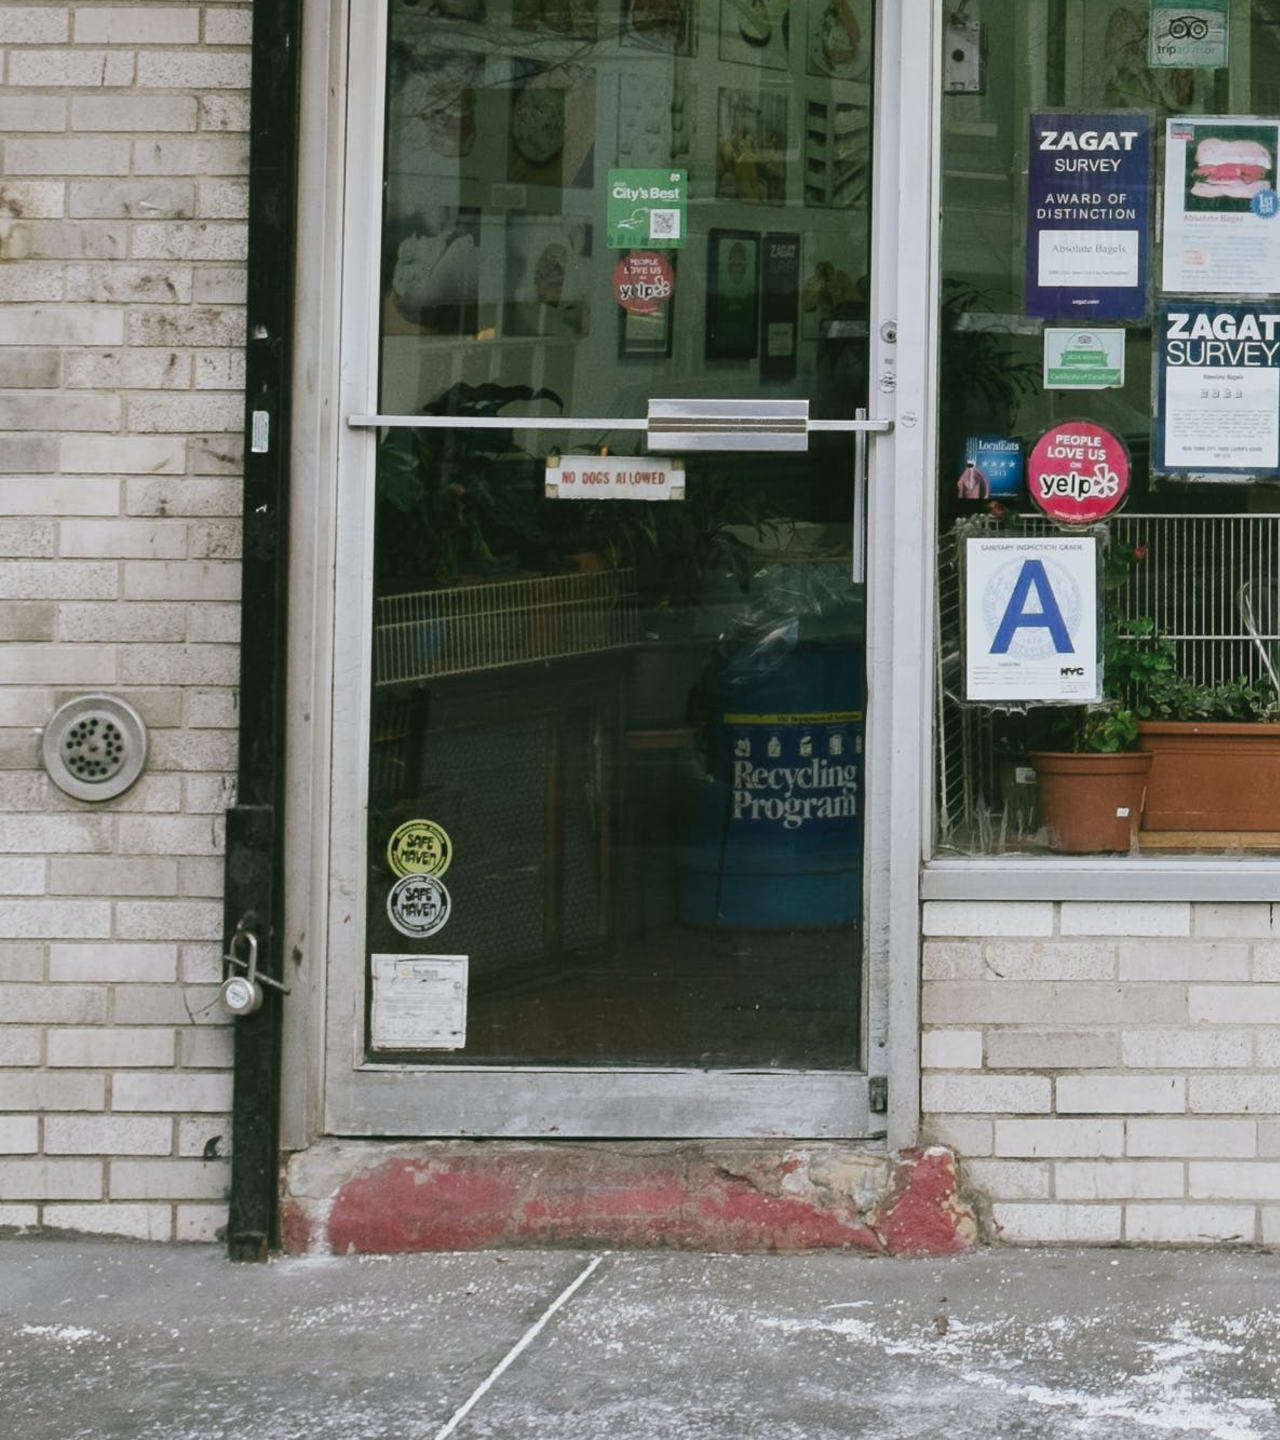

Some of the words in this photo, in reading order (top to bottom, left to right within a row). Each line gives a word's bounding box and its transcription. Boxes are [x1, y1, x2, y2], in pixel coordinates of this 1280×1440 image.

[1039, 130, 1138, 151] ZAGAT
[1054, 158, 1122, 173] SURVEY
[612, 186, 648, 201] City's
[650, 186, 681, 199] Best
[1045, 193, 1102, 205] AWARD
[1107, 193, 1128, 205] OF
[1036, 208, 1136, 220] DISTINCTION
[1052, 244, 1093, 254] Absolute
[1095, 244, 1127, 256] Bagels
[628, 258, 660, 267] PEOPLE
[624, 266, 647, 275] LOVE
[650, 266, 663, 275] US
[620, 281, 656, 300] yelp
[1166, 341, 1280, 366] SURVEY
[978, 440, 1019, 452] LocalEats
[1056, 434, 1102, 447] PEOPLE
[1047, 446, 1084, 459] LOVE
[1087, 448, 1107, 460] US
[561, 471, 576, 485] NO
[582, 471, 610, 485] DOGS
[615, 471, 666, 485] ALLOWED
[1041, 474, 1092, 499] yelp
[988, 558, 1076, 655] A
[1060, 667, 1084, 676] NYC
[733, 757, 858, 799] Recycling
[733, 790, 857, 830] Program
[407, 834, 434, 851] SAFE
[401, 850, 437, 866] HAVEN
[405, 886, 432, 902] SAFE
[401, 902, 437, 918] HAVEN
